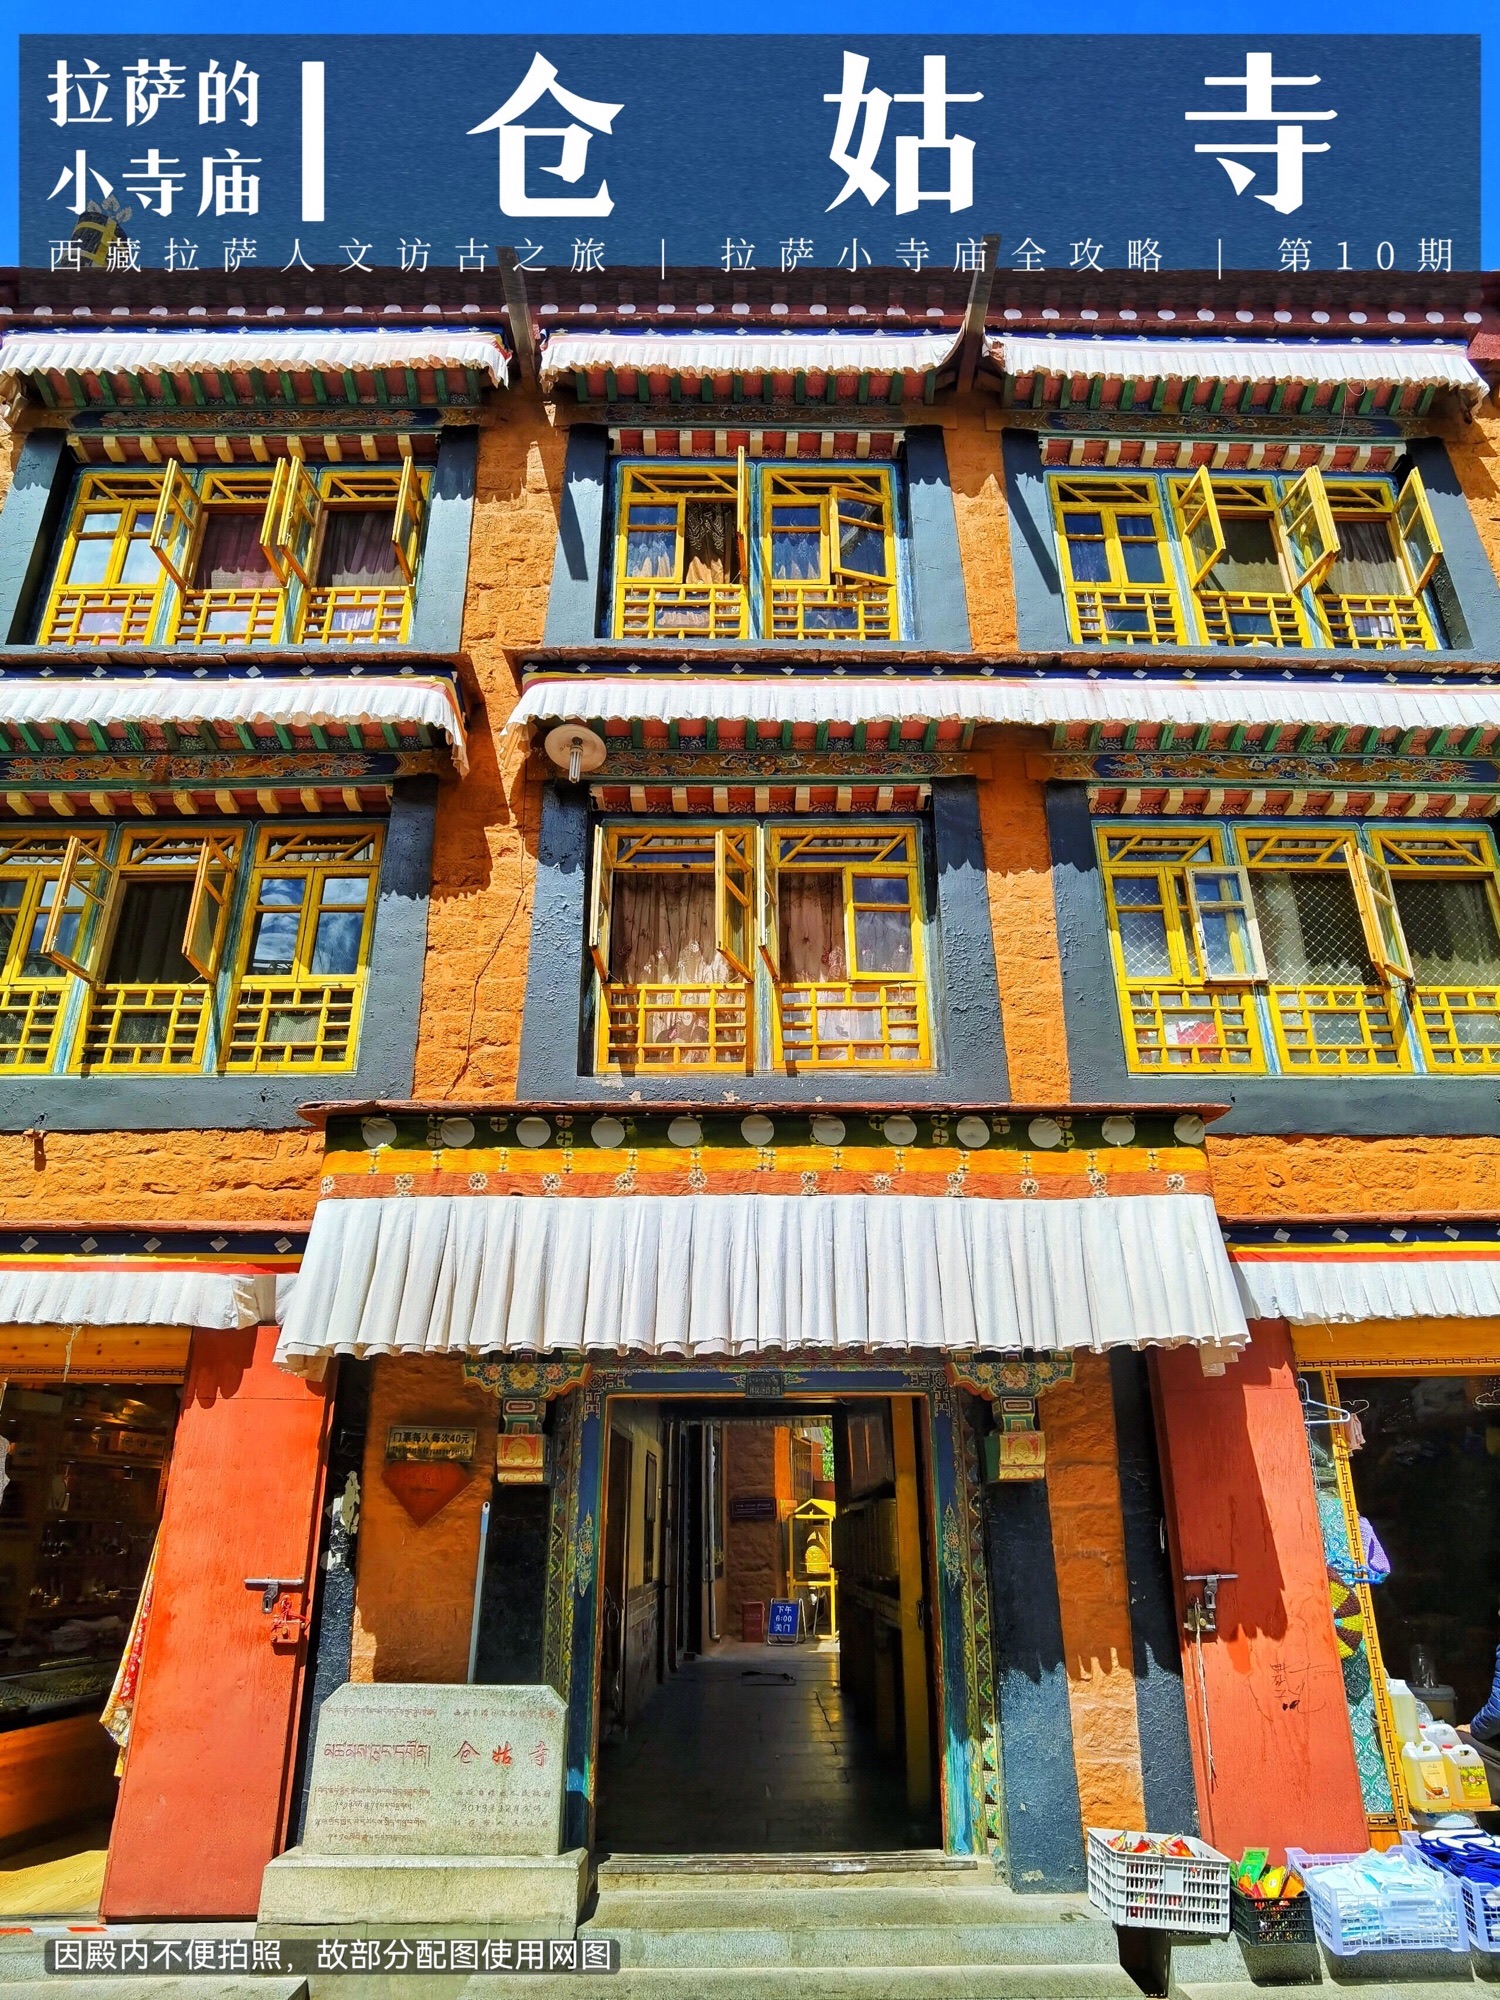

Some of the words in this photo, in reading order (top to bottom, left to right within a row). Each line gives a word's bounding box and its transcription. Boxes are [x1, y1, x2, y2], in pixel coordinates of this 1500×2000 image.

[393, 1431, 470, 1444] 门票每人每次40元
[776, 1605, 792, 1614] 下午
[775, 1614, 793, 1622] 6:00
[774, 1623, 791, 1632] 关门
[452, 1740, 550, 1769] 仓姑寺
